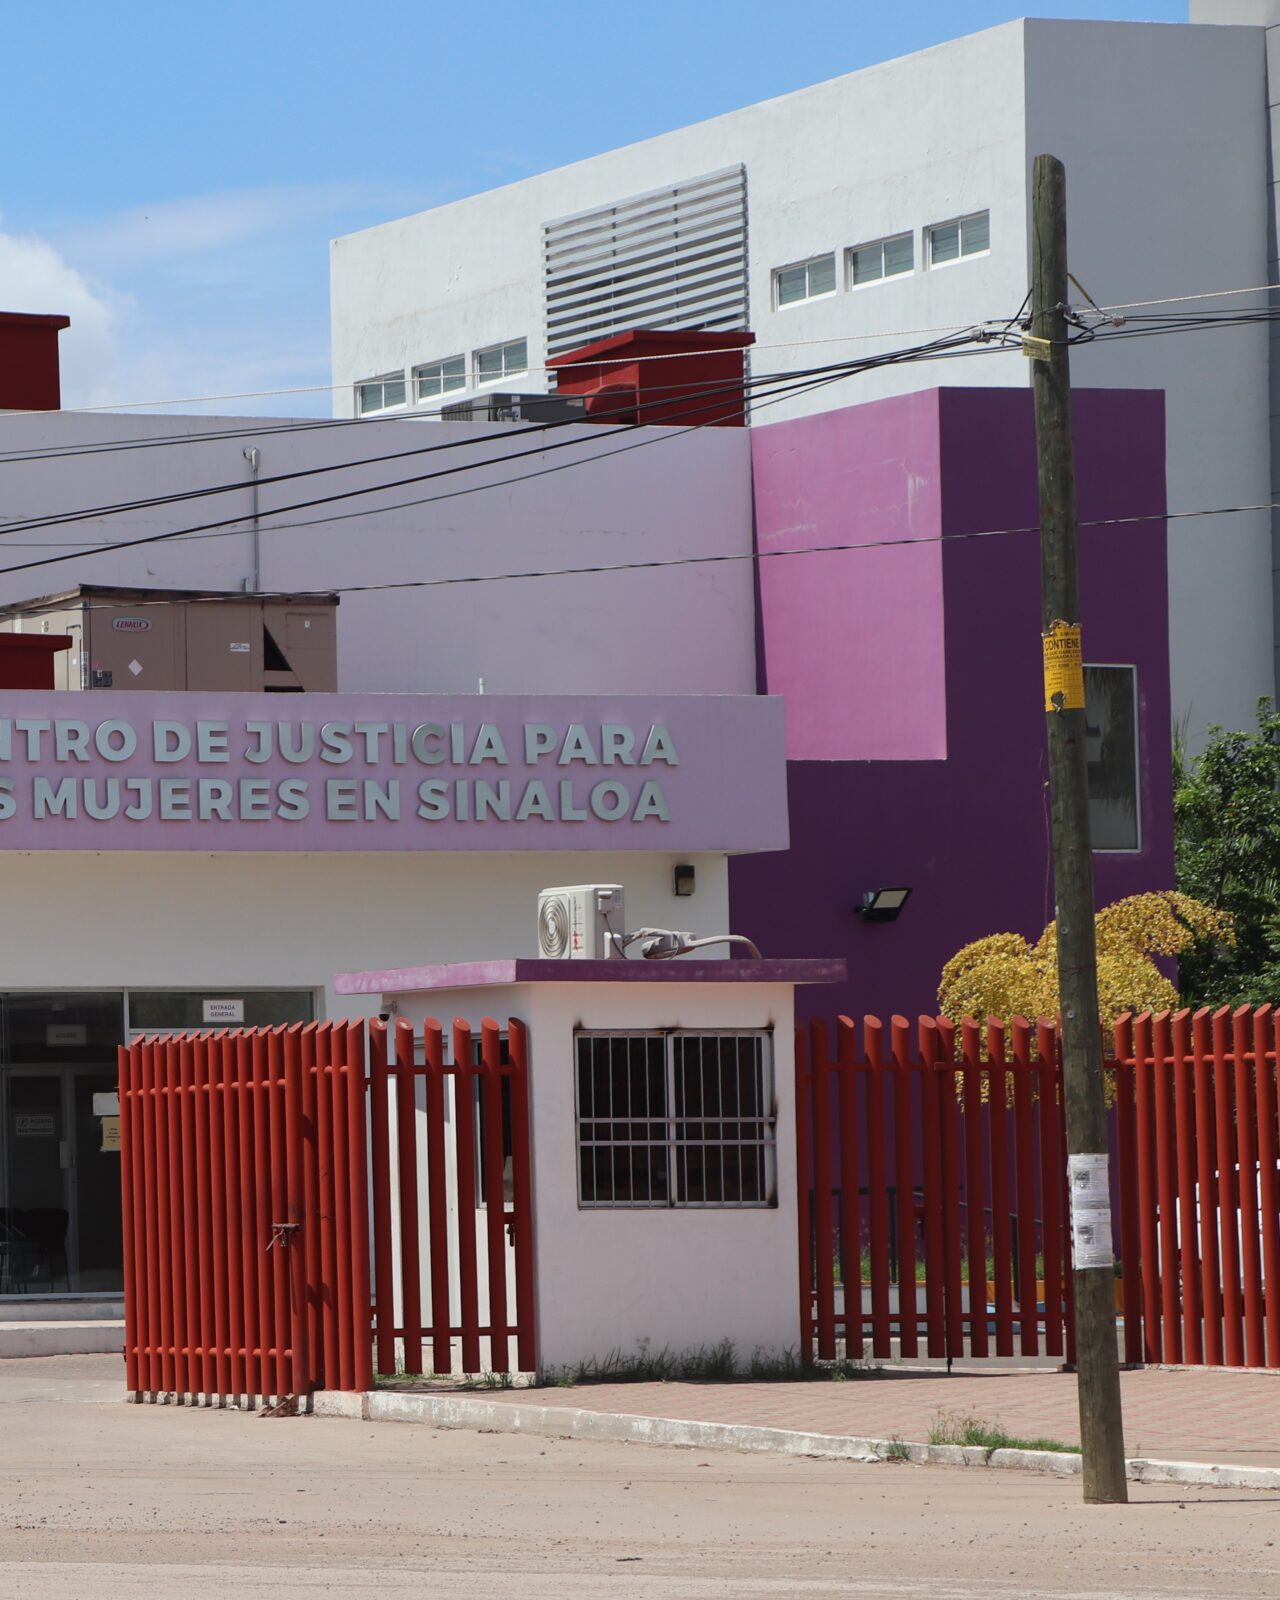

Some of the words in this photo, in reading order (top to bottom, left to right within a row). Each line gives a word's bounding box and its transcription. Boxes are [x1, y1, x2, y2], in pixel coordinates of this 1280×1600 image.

[153, 719, 230, 763] DE
[244, 721, 510, 764] JUSTICIA
[524, 722, 680, 766] PARA
[32, 777, 310, 821] MUJERES
[326, 779, 401, 821] EN
[417, 779, 672, 822] SINALOA
